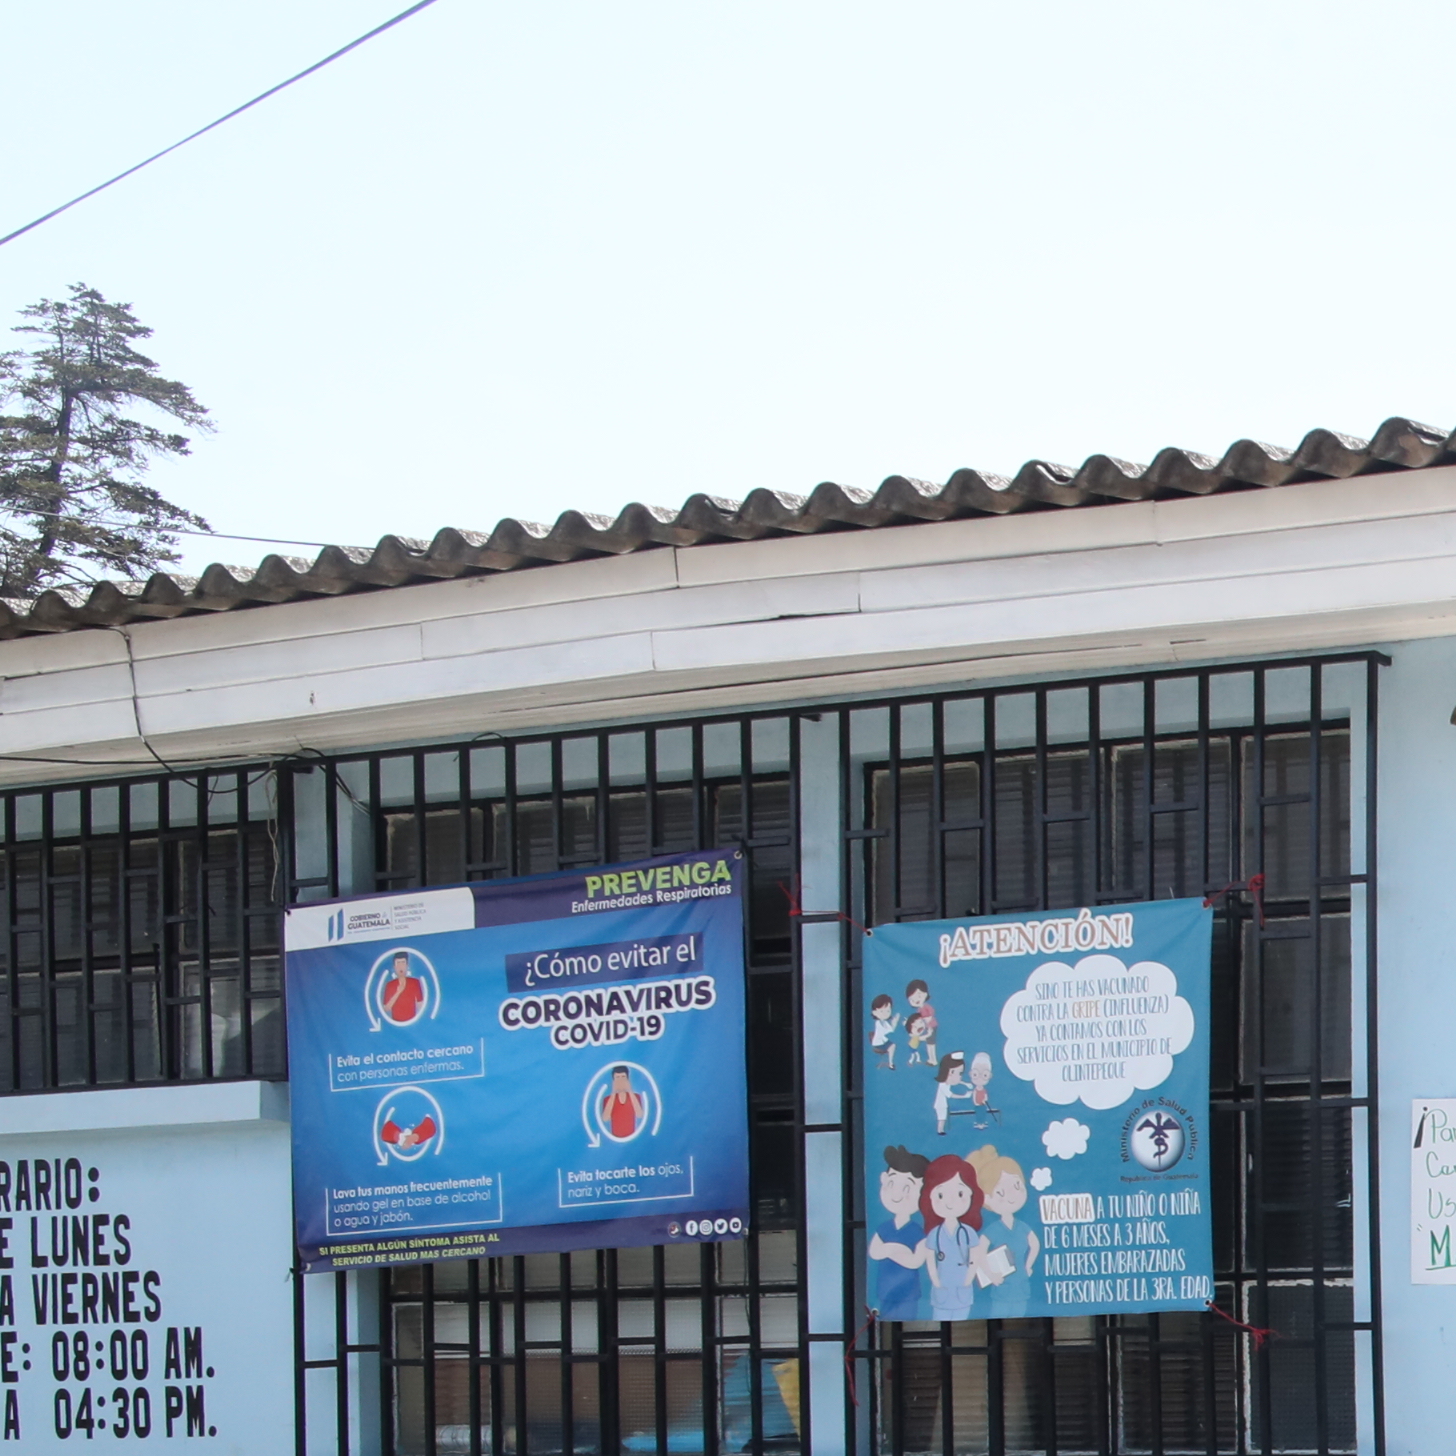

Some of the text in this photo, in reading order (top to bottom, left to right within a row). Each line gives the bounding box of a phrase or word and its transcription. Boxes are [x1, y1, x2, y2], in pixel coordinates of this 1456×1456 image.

[585, 860, 732, 898] PREVENGA
[572, 884, 732, 913] Enfermedades Respiratorias
[347, 919, 390, 930] GUATEMALA
[940, 910, 1132, 966] ¡ATENCIÓN!
[524, 935, 696, 987] ¿Cómo evitar el
[1062, 981, 1073, 998] TE
[1076, 979, 1095, 997] HAS
[1097, 976, 1149, 996] VACUNADO
[502, 979, 713, 1027] CORONAVIRUS
[1017, 994, 1169, 1022] CONTRA LA GRIPE (INFLUENZA)
[554, 1014, 662, 1046] COVID-19
[1035, 1018, 1147, 1042] YA CONTAMOS CON LOS
[337, 1045, 474, 1068] Evita el contacto cercano
[1017, 1037, 1172, 1064] SERVICIOS EN EL MUNICIPIO DE
[337, 1060, 465, 1082] con personas enfermas.
[1120, 1107, 1140, 1163] Ministerio
[1142, 1098, 1155, 1110] de
[1158, 1096, 1188, 1116] Salud
[333, 1175, 493, 1200] Lava tus manos frecuentemente
[567, 1171, 593, 1183] Evita
[595, 1166, 636, 1181] tocarte
[639, 1165, 655, 1177] los
[334, 1189, 491, 1214] usando gel en base de alcohol
[568, 1182, 640, 1198] nariz y boca.
[1043, 1188, 1201, 1220] VACUNA A TU NIÑO O NIÑA
[334, 1210, 413, 1230] o agua y jabón.
[1044, 1218, 1170, 1249] DE 6 MESES A 3 AÑOS,
[30, 1214, 131, 1268] LUNES
[319, 1233, 500, 1256] SI PRESENTA ALGÚN SÍNTOMA ASISTA AL
[332, 1256, 372, 1267] SERVICIO
[375, 1254, 387, 1263] DE
[388, 1251, 418, 1262] SALUD
[442, 1246, 486, 1257] CERCANO
[1045, 1249, 1186, 1277] MUJERES EMBARAZADAS
[0, 1270, 161, 1326] A VIERNES
[1045, 1275, 1213, 1304] Y PERSONAS DE LA 3RA. EDAD.
[52, 1329, 149, 1382] 08:00
[164, 1327, 215, 1379] AM.
[4, 1385, 217, 1440] A 04:30 PM.
